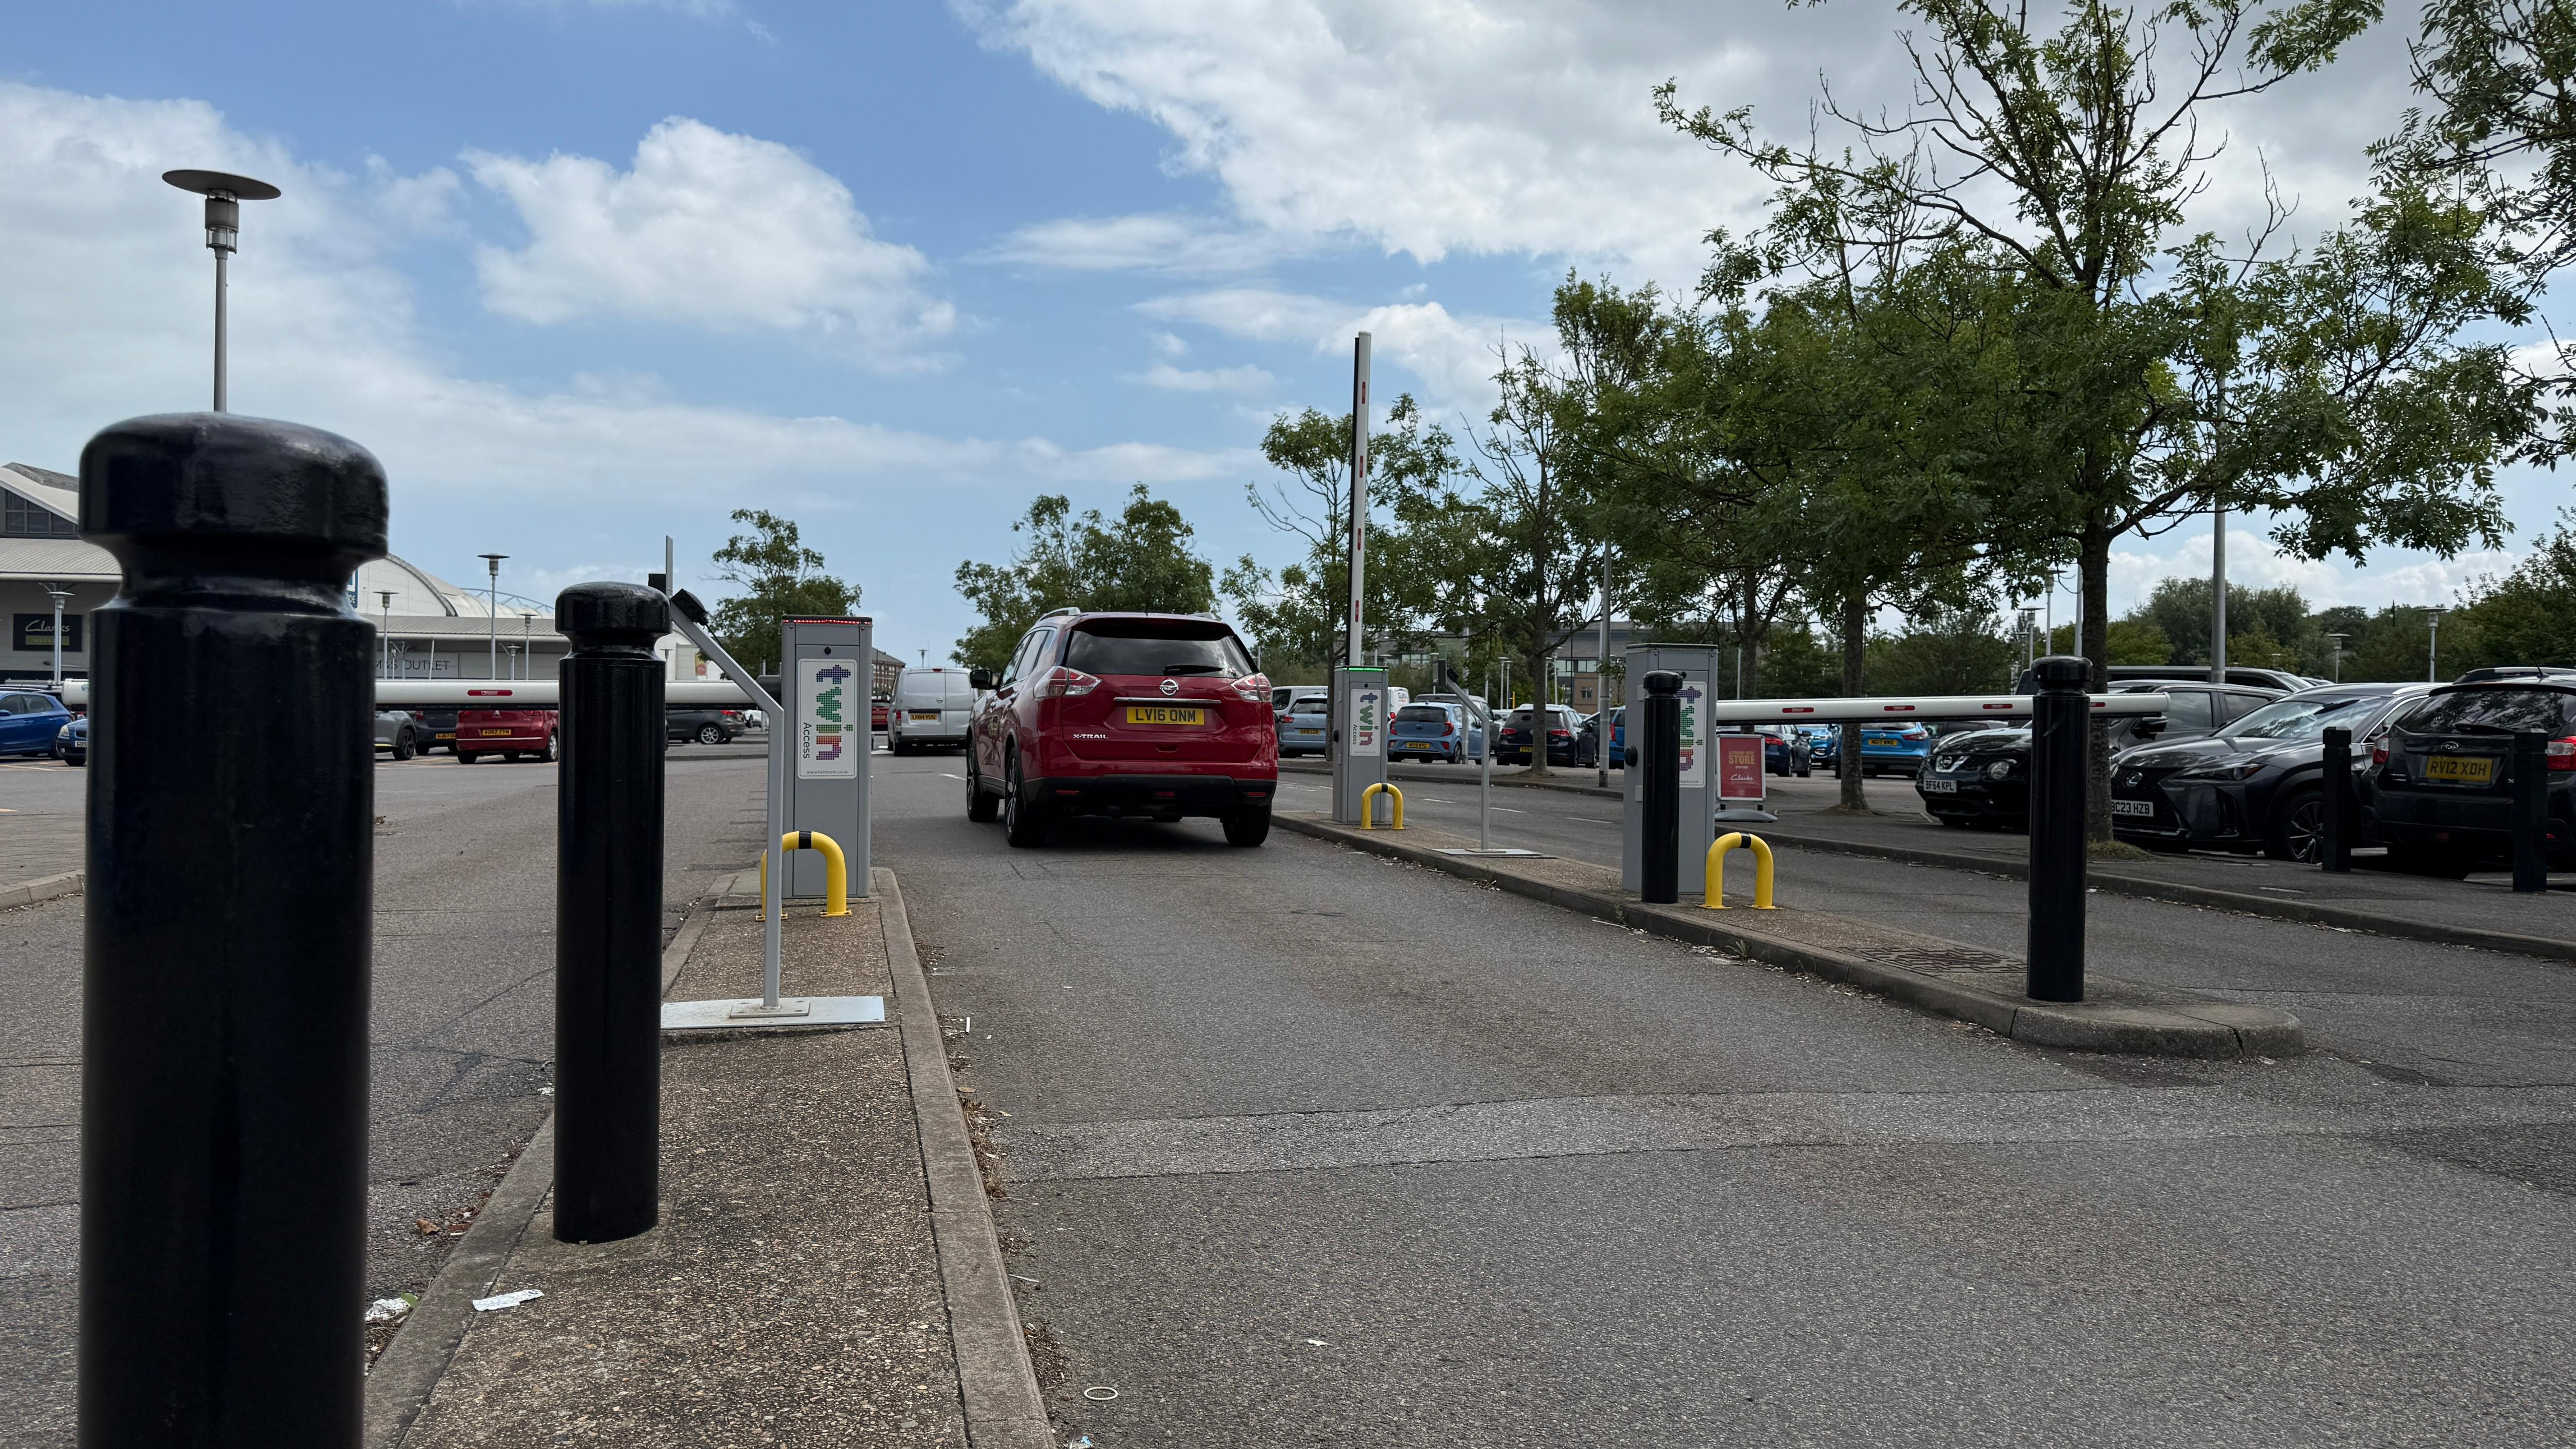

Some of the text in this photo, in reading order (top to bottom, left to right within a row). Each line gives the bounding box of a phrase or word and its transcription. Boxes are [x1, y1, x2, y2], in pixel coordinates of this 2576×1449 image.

[816, 665, 853, 760] twin
[1135, 708, 1195, 722] LV16 ONM
[1359, 692, 1379, 746] twin
[803, 722, 812, 759] Access
[1728, 755, 1755, 765] STORE
[2430, 761, 2487, 776] RV12 XDH
[1926, 780, 1954, 790] BF64 KPL
[2133, 803, 2149, 814] HZB
